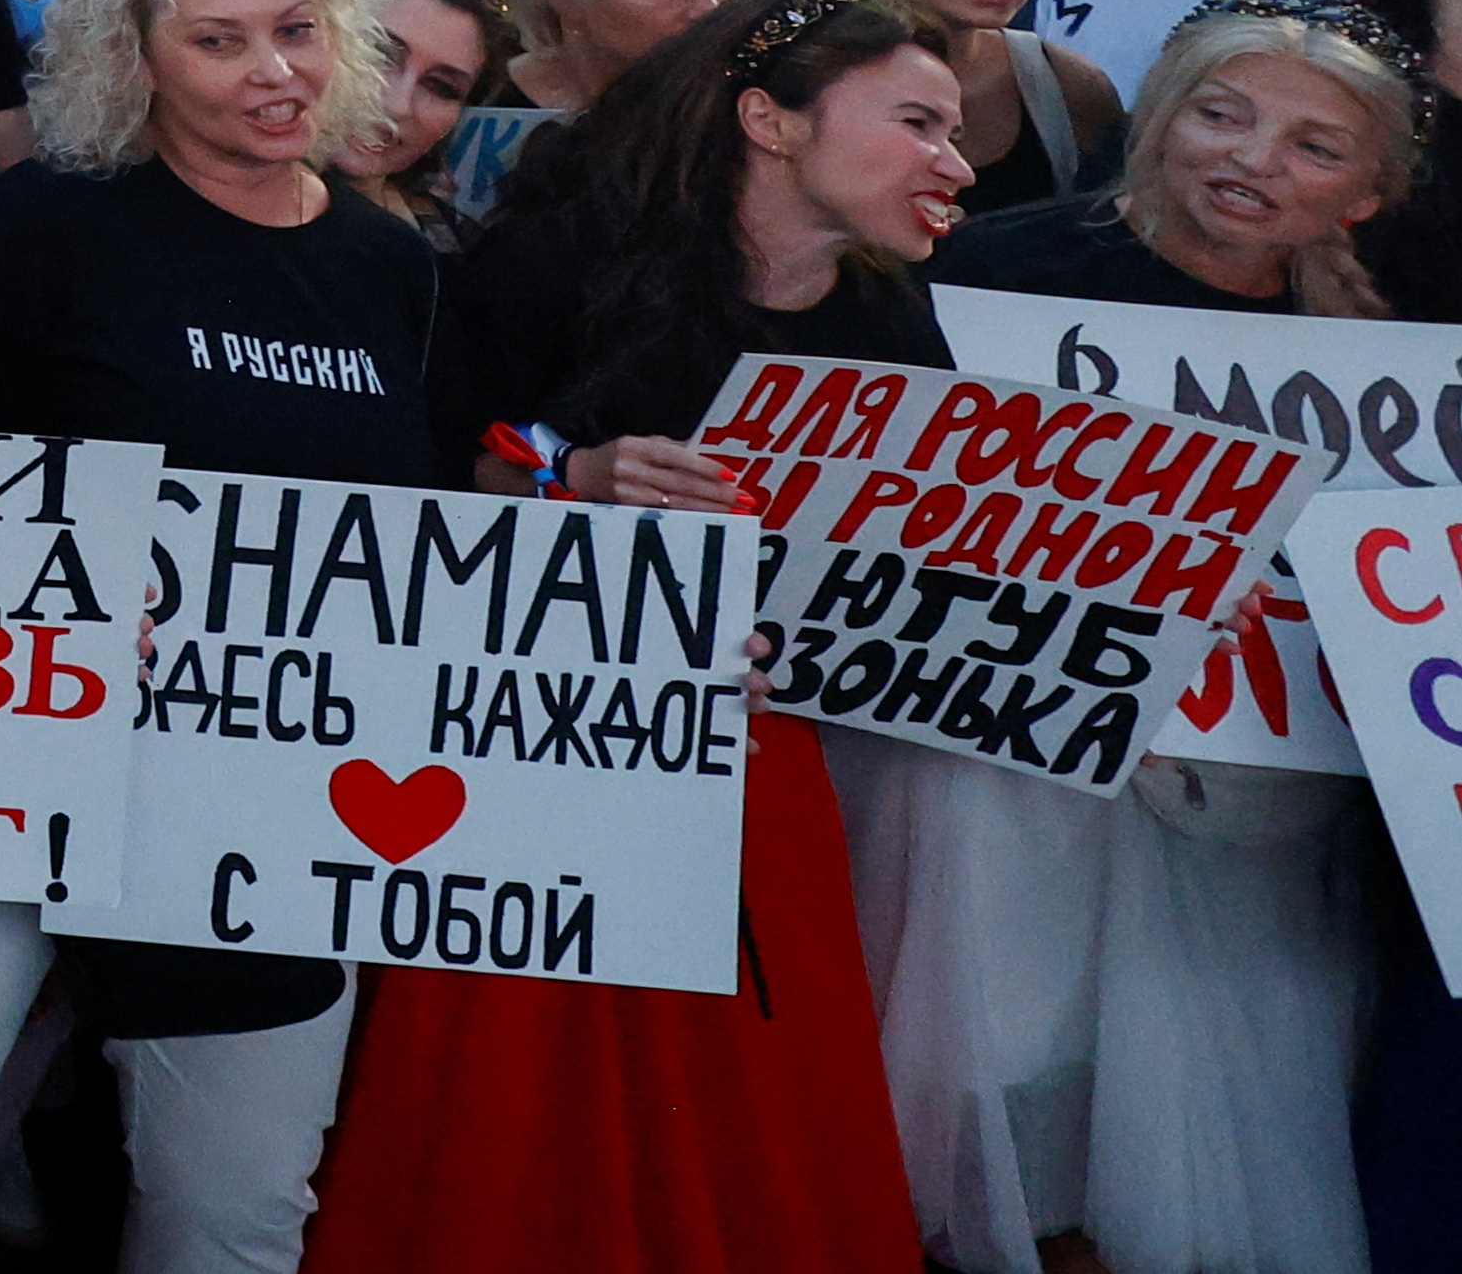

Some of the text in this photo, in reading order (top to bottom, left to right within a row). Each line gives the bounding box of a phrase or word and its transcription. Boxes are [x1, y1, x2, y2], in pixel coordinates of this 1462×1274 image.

[186, 327, 386, 397] Я РУССКИЙ
[700, 362, 1301, 536] ДЛЯ РОССИИ
[826, 469, 1242, 622] РОДНОЙ
[802, 548, 1165, 688] ЮТУБ
[429, 662, 743, 777] КАЖДОЕ
[211, 851, 595, 976] С ТОБОЙ
